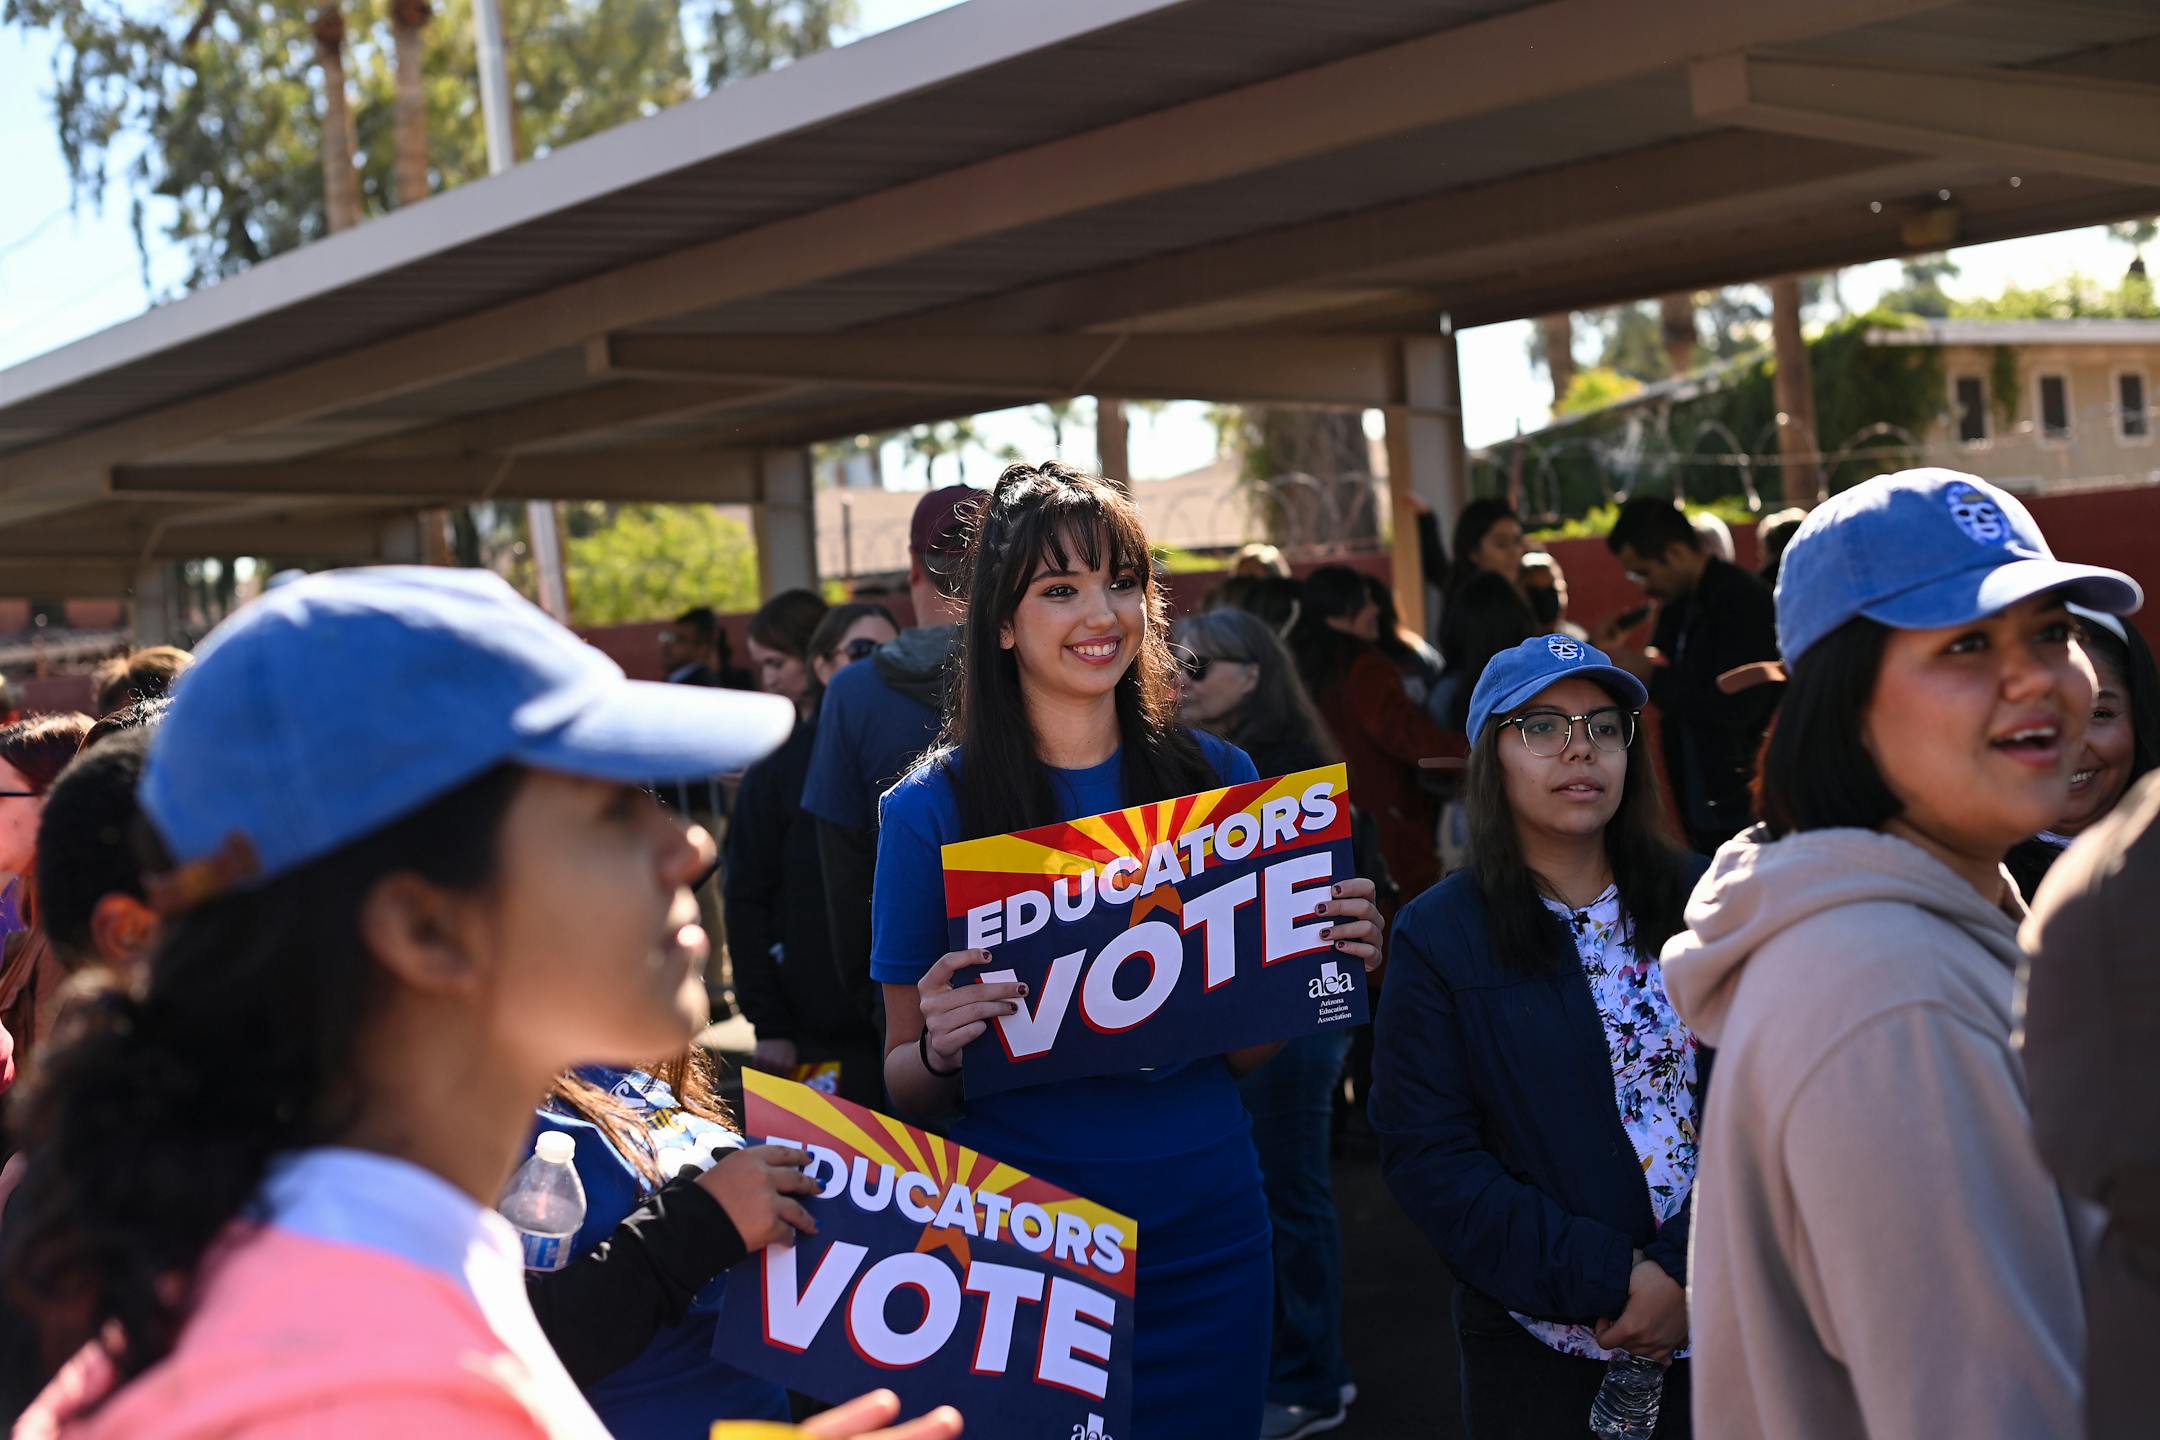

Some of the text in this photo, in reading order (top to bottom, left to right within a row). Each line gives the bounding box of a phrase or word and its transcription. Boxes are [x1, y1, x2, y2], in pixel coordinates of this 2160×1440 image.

[966, 781, 1338, 950] EDUCATORS
[978, 850, 1336, 1060] VOTE
[1317, 1012, 1351, 1024] Association
[1319, 1005, 1348, 1015] Education
[1320, 998, 1344, 1007] Arizona
[765, 1135, 1126, 1275] DUCATORS
[763, 1240, 1117, 1399] VOTE
